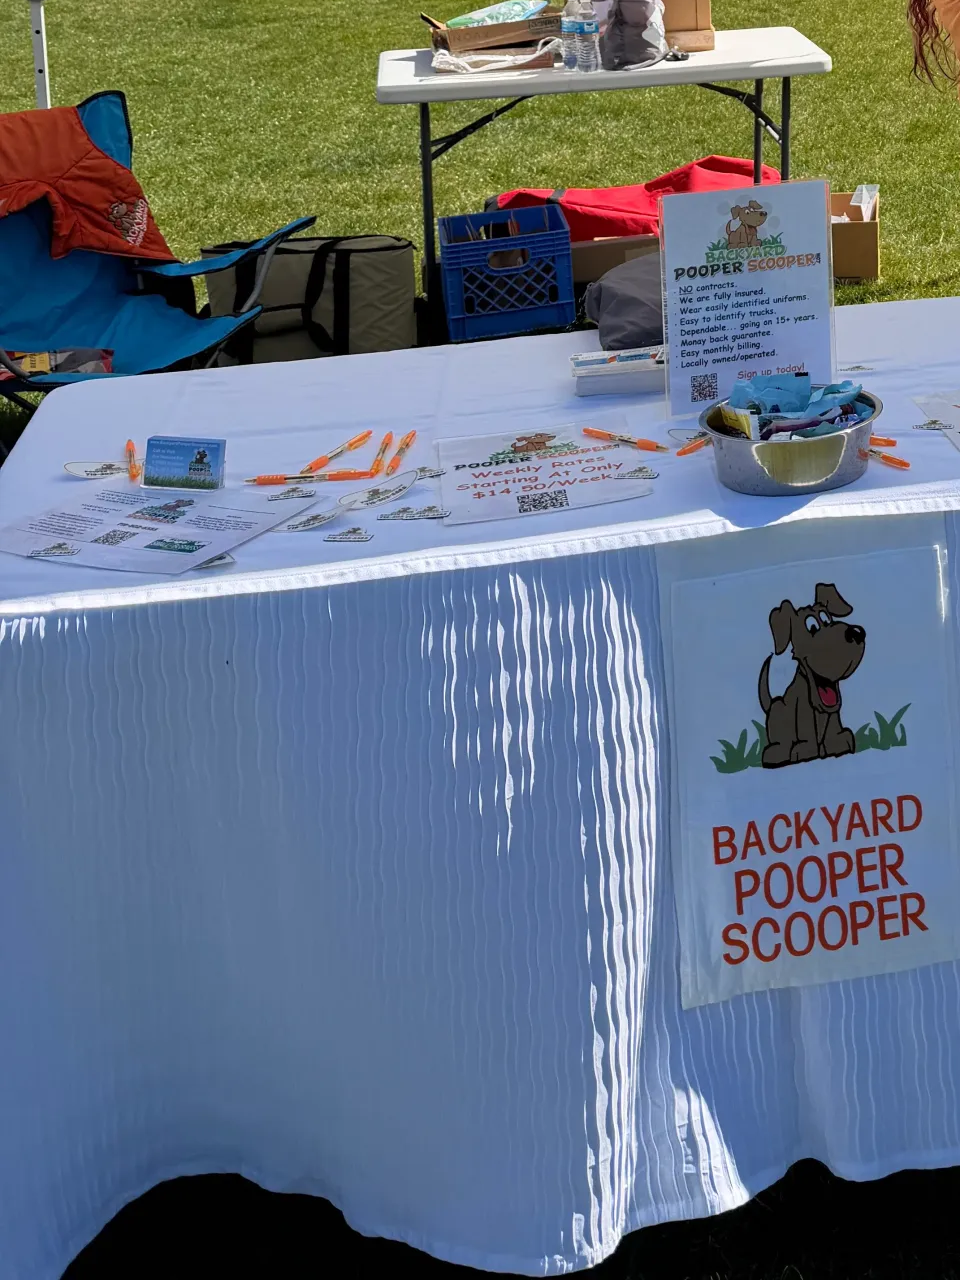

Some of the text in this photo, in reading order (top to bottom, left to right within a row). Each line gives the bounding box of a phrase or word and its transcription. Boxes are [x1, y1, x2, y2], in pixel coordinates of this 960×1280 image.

[705, 244, 787, 264] BACKYARD
[673, 253, 815, 282] POOPER SCOOPER
[679, 281, 738, 295] NO contracts.
[679, 296, 693, 304] We
[713, 291, 731, 301] fully
[734, 287, 766, 298] insured.
[680, 294, 809, 315] Wear easily identified uniforms.
[680, 318, 699, 327] Easy
[714, 311, 746, 322] identify
[749, 309, 776, 318] trucks.
[680, 324, 737, 337] Dependable...
[740, 321, 760, 331] going
[776, 316, 790, 325] 15+
[794, 313, 818, 324] years.
[709, 333, 729, 343] back
[731, 330, 774, 341] guarantee.
[680, 341, 763, 358] Easy monthly billing.
[680, 349, 778, 369] Locally owned/operated.
[737, 369, 758, 381] Sign
[775, 362, 806, 375] today!
[453, 456, 533, 471] POOPER
[471, 456, 606, 480] Weekly Rates
[456, 462, 623, 491] Starting At Only
[472, 473, 613, 500] $14.50/Week
[712, 793, 923, 866] BACKYARD
[734, 842, 909, 916] POOPER
[721, 891, 929, 966] SCOOPER
